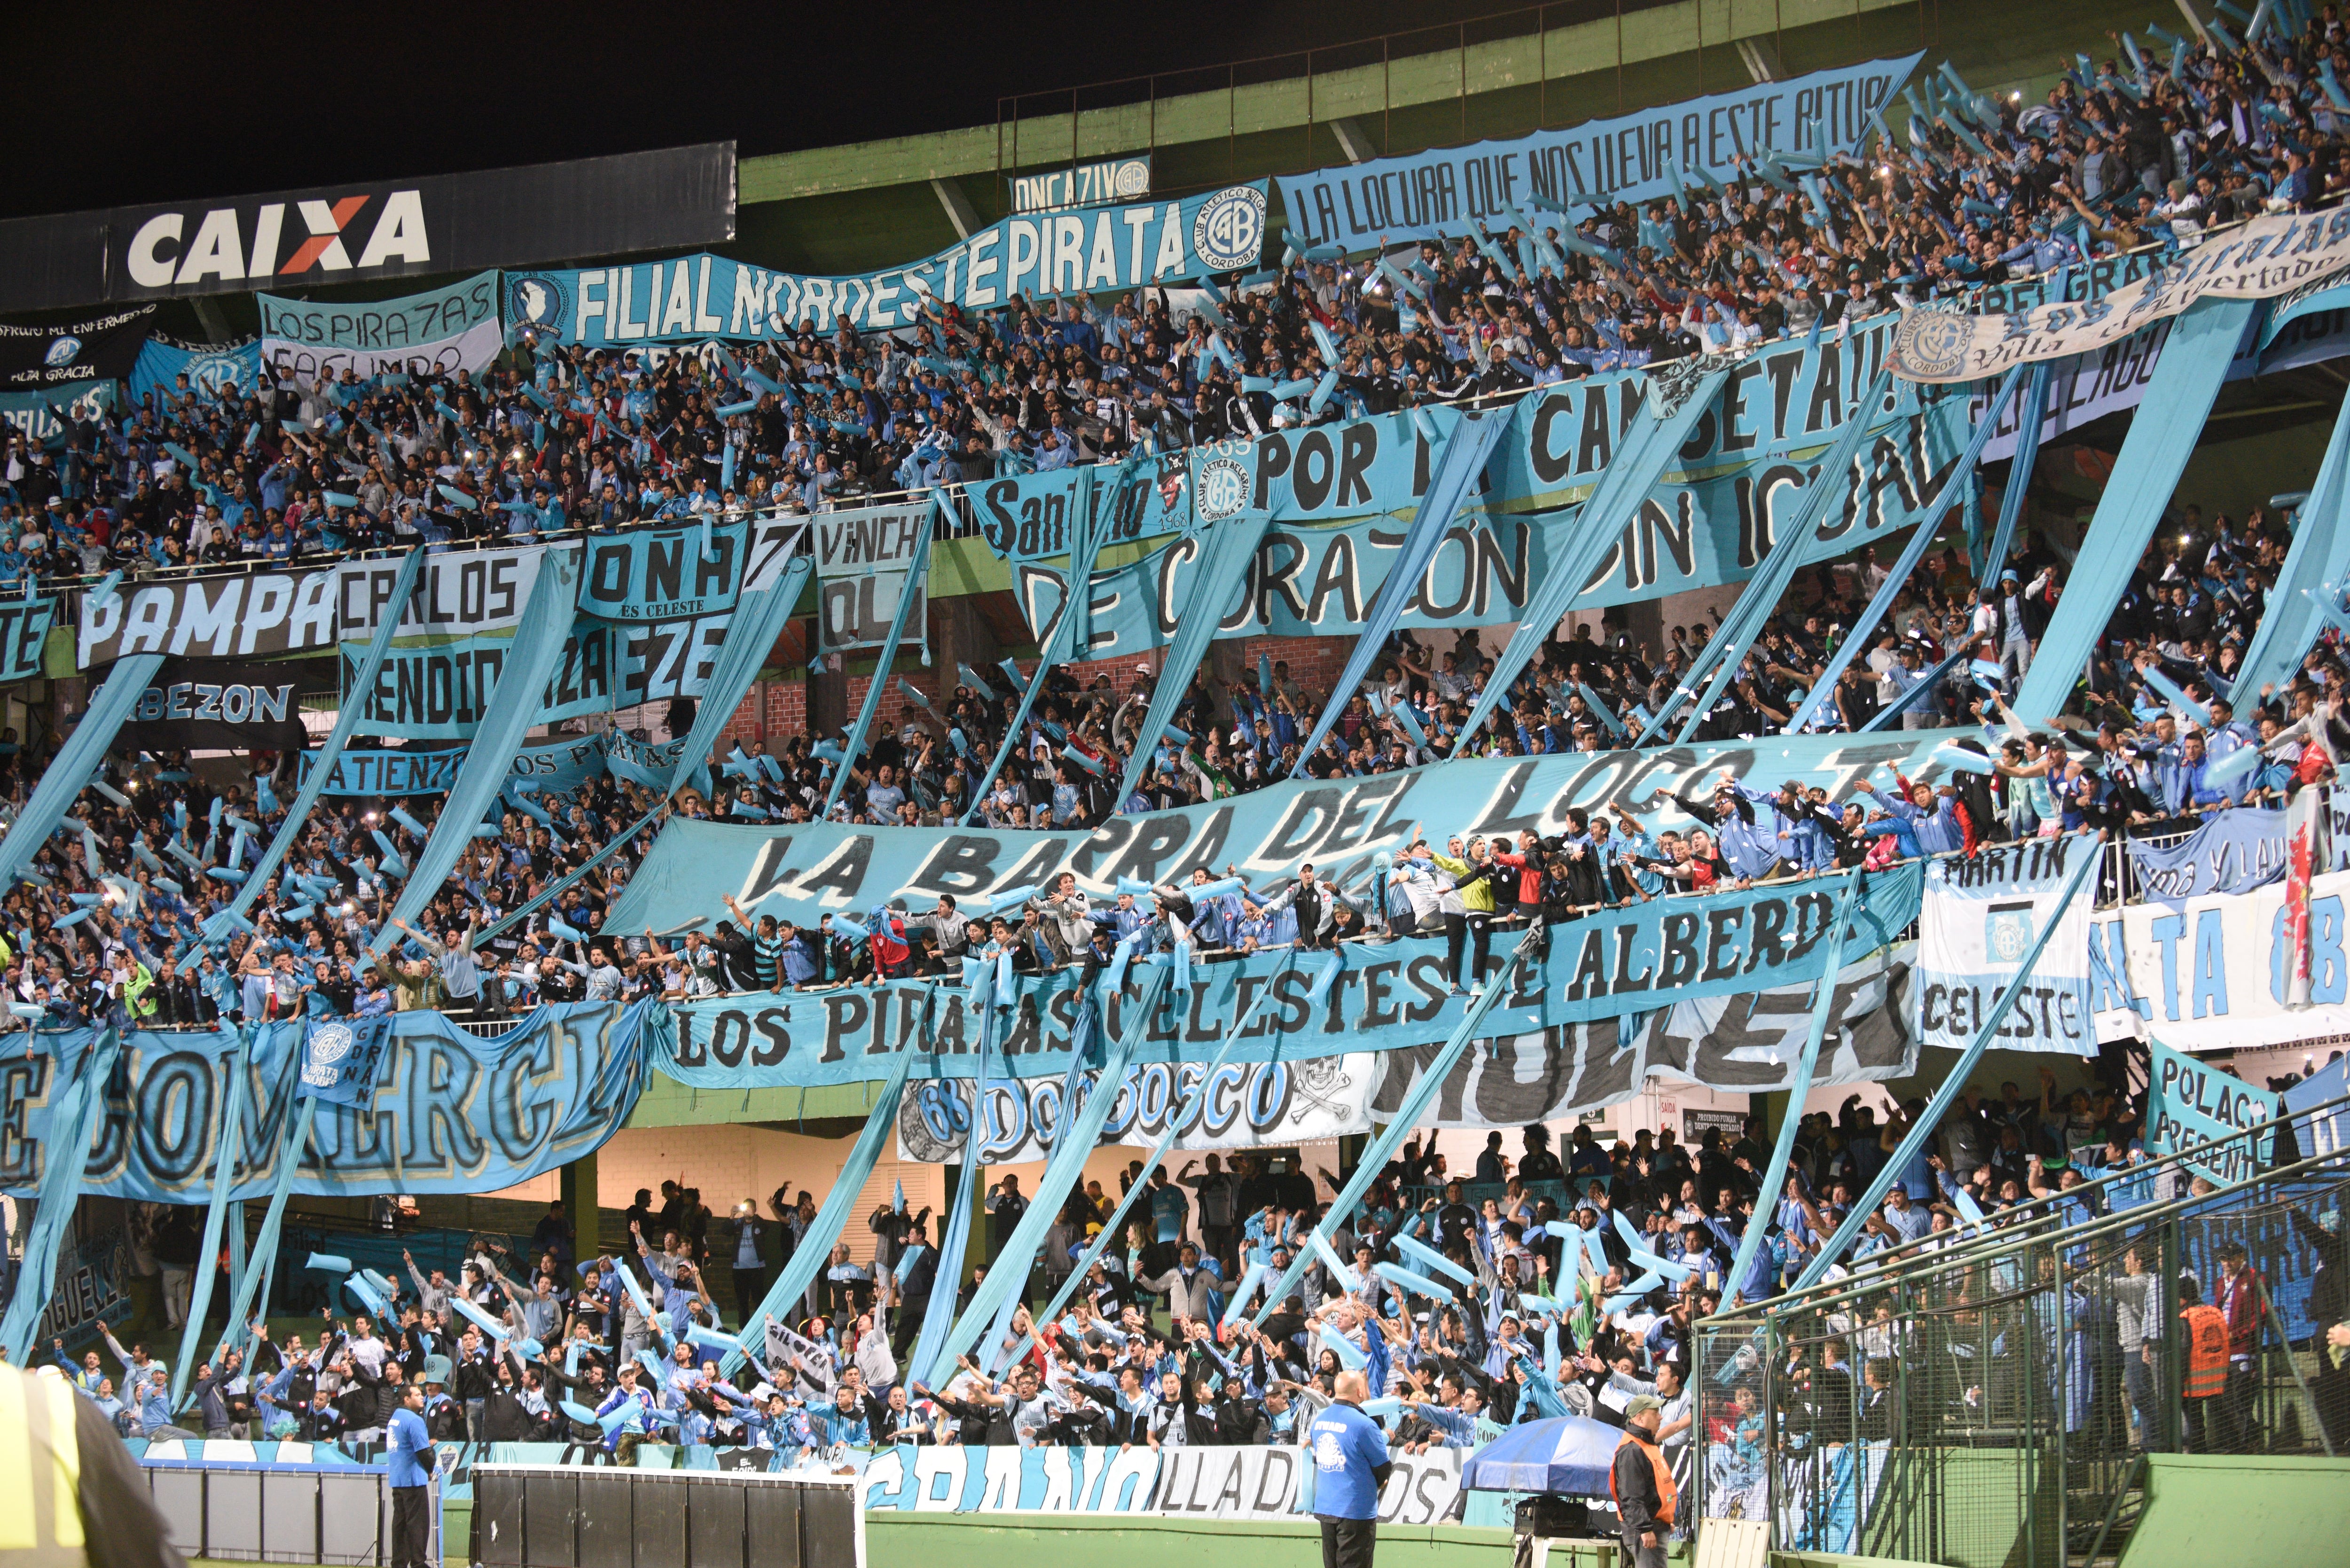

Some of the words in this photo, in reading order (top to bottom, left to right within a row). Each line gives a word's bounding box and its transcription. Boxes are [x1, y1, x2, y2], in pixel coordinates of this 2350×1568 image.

[1294, 182, 1342, 246] LA
[1340, 170, 1457, 235] LOCURA
[1463, 154, 1520, 221] QUE
[1528, 141, 1585, 213] NOS
[1592, 119, 1673, 195] LLEVA
[1681, 112, 1700, 171] A
[1708, 93, 1783, 169] ESTE
[1793, 74, 1892, 153] RITUA
[127, 189, 431, 288] CAIXA
[574, 256, 723, 341] FILIAL
[729, 228, 1001, 335] NORDESTE
[1007, 202, 1186, 296] PIRATA
[1205, 249, 1257, 268] CORDOBA
[46, 365, 95, 382] GRACIA
[1252, 422, 1379, 512] POR
[77, 571, 336, 671] PAMPA
[621, 604, 640, 618] ES
[646, 599, 705, 618] CELESTE
[88, 682, 296, 723] BEZON
[734, 834, 874, 909] LA
[1246, 772, 1416, 870] DEL
[1944, 837, 2074, 888] MARTIN
[674, 1003, 791, 1069] LOS
[1104, 953, 1450, 1045] CELESTES
[1661, 1098, 1676, 1114] SAÍDA
[1694, 1122, 1713, 1131] DENTRO
[1720, 1123, 1740, 1132] ESTÁDIO
[1697, 1113, 1720, 1123] PROIBIDO
[1720, 1115, 1737, 1123] FUMAR
[2162, 1057, 2268, 1141] POLACO
[2153, 1110, 2265, 1185] PRESENT
